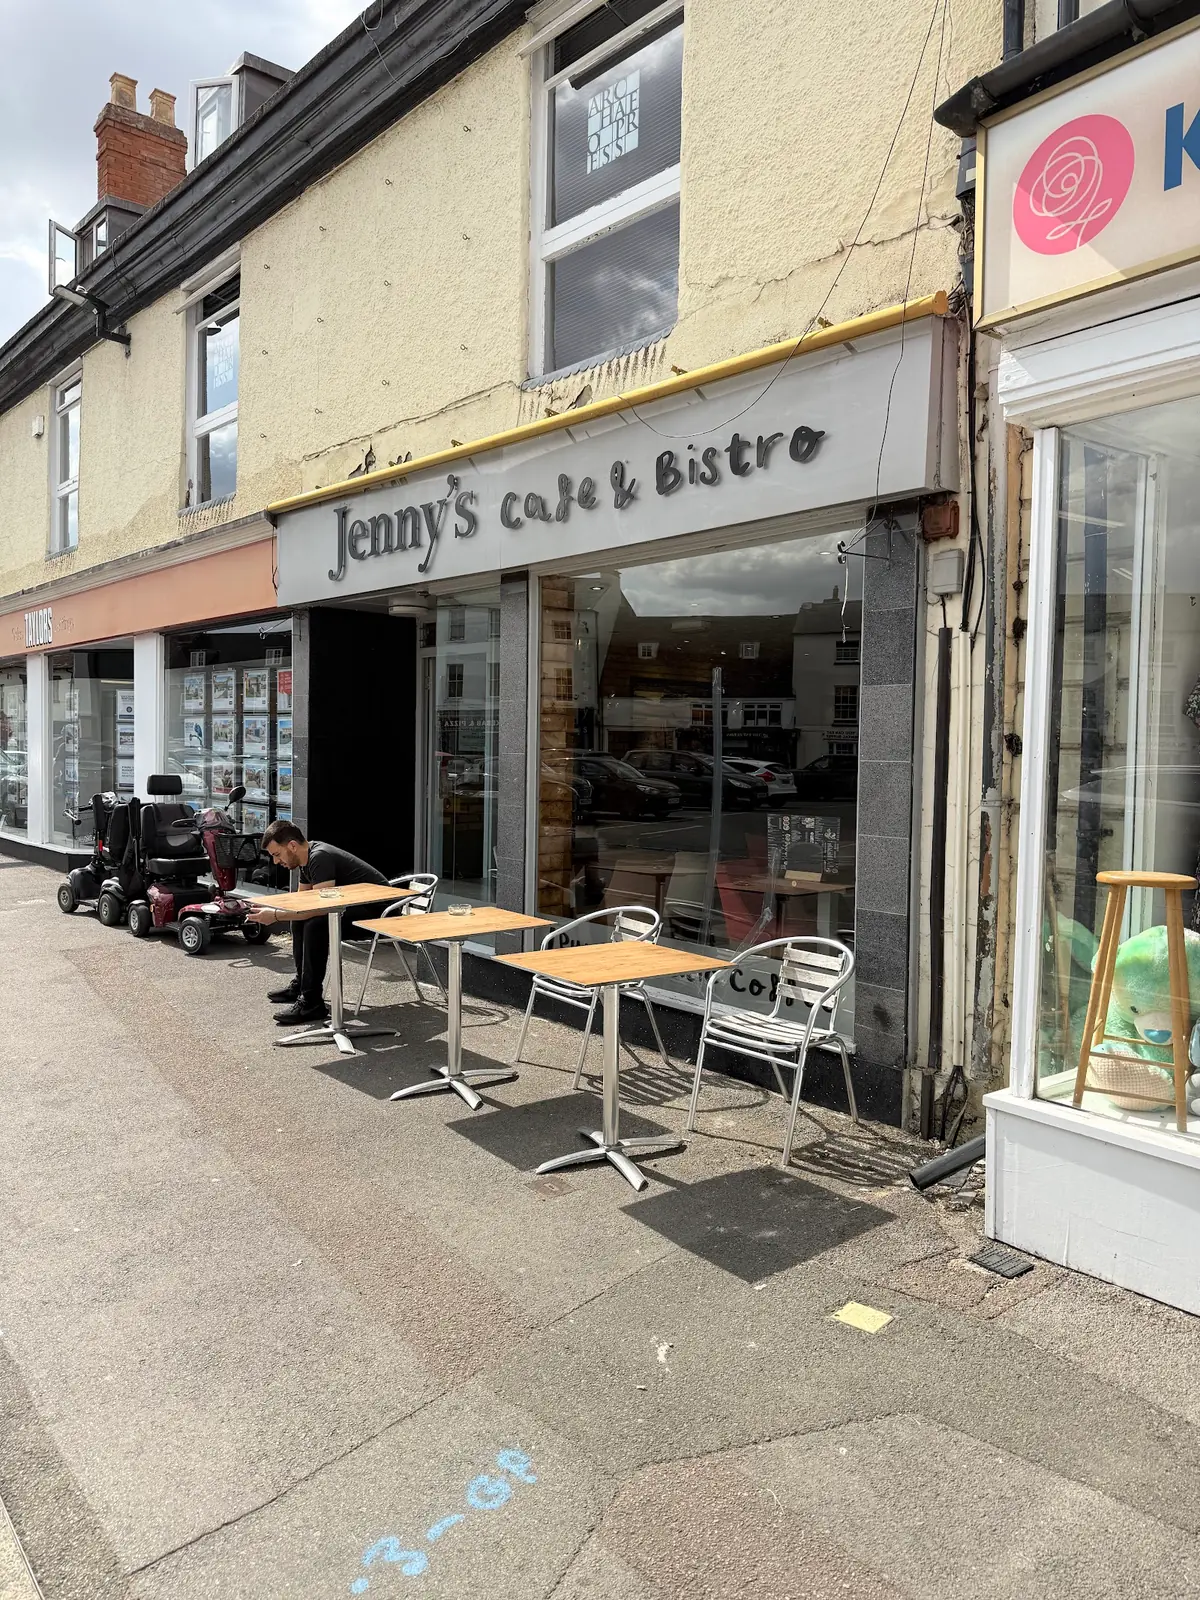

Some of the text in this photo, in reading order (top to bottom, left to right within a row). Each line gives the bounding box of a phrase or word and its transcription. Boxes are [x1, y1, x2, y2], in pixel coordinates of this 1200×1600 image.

[328, 473, 478, 581] Jenny's
[609, 459, 637, 509] &
[655, 425, 825, 495] Bistro
[24, 607, 52, 648] TAYLORS
